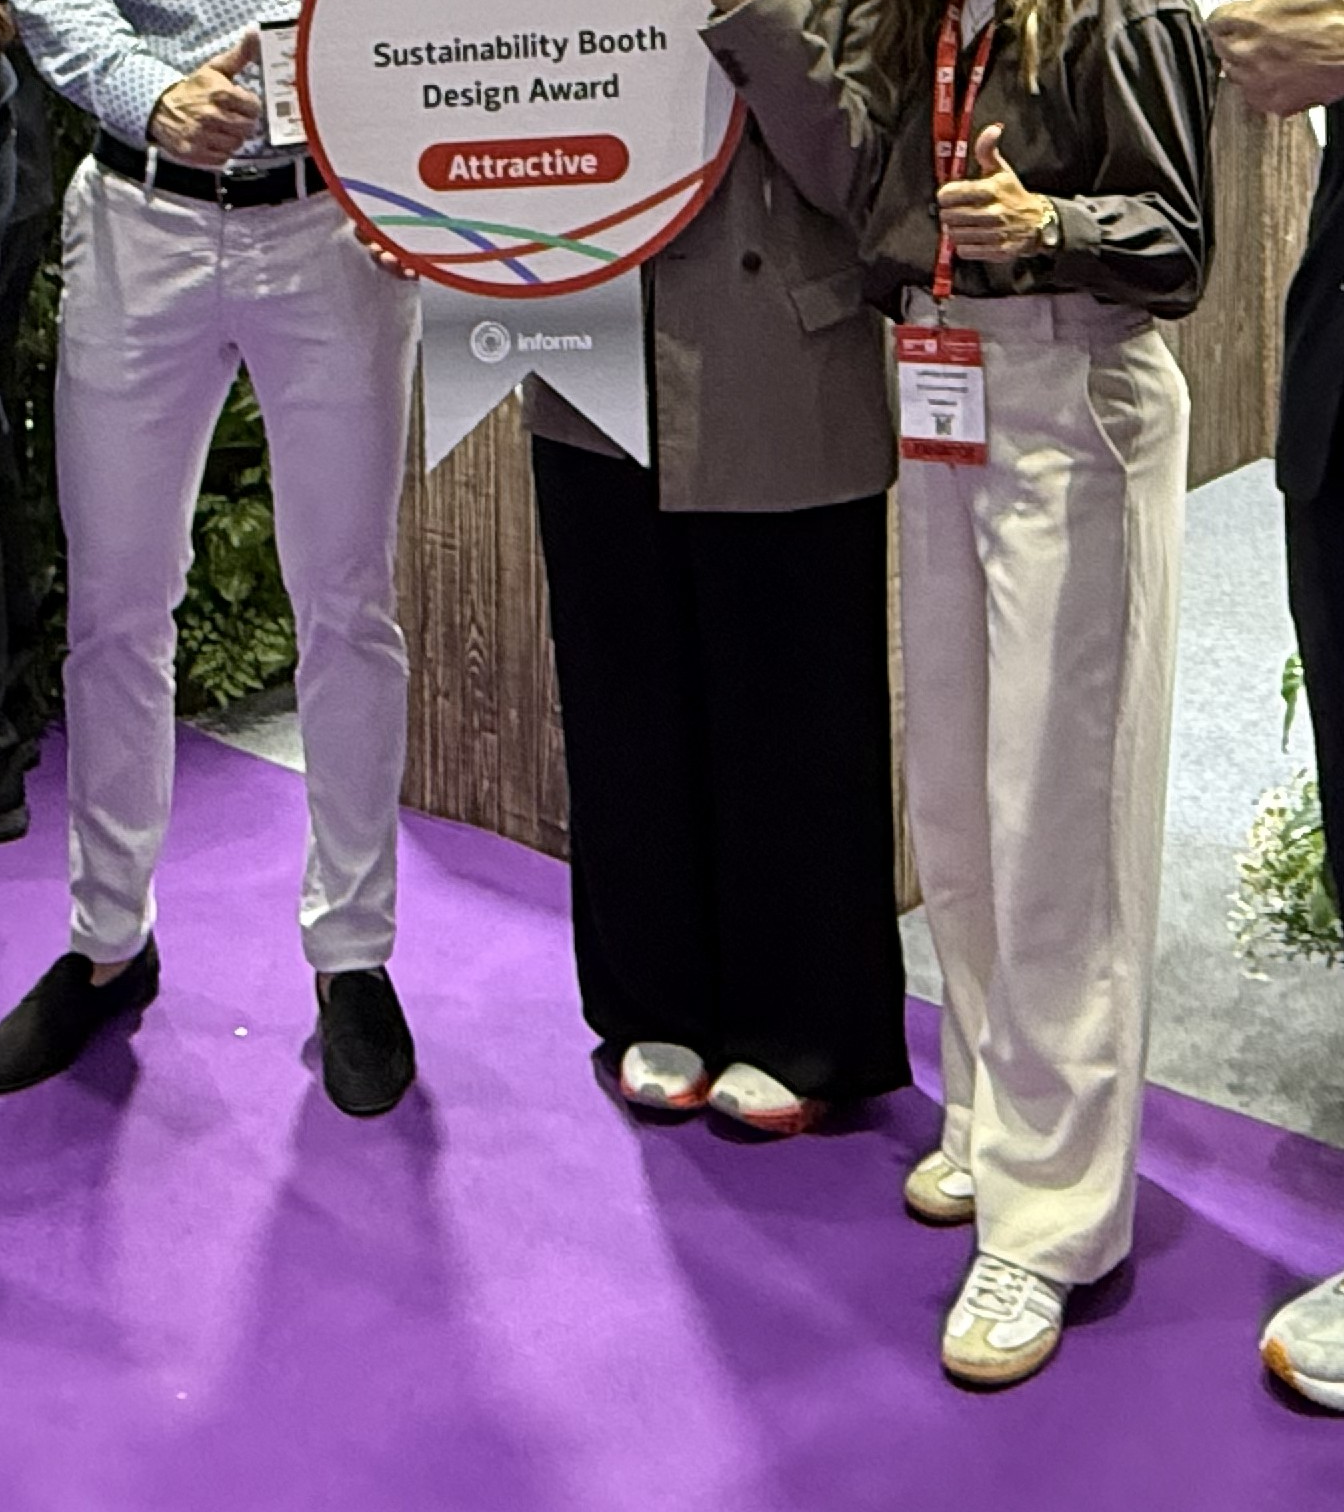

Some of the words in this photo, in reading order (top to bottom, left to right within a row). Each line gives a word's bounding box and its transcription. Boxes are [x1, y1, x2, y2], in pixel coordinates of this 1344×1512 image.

[373, 33, 569, 68] Sustainability
[578, 26, 668, 56] Booth
[422, 80, 520, 112] Design
[528, 73, 620, 104] Award
[448, 149, 598, 181] Attractive
[517, 331, 593, 352] informa
